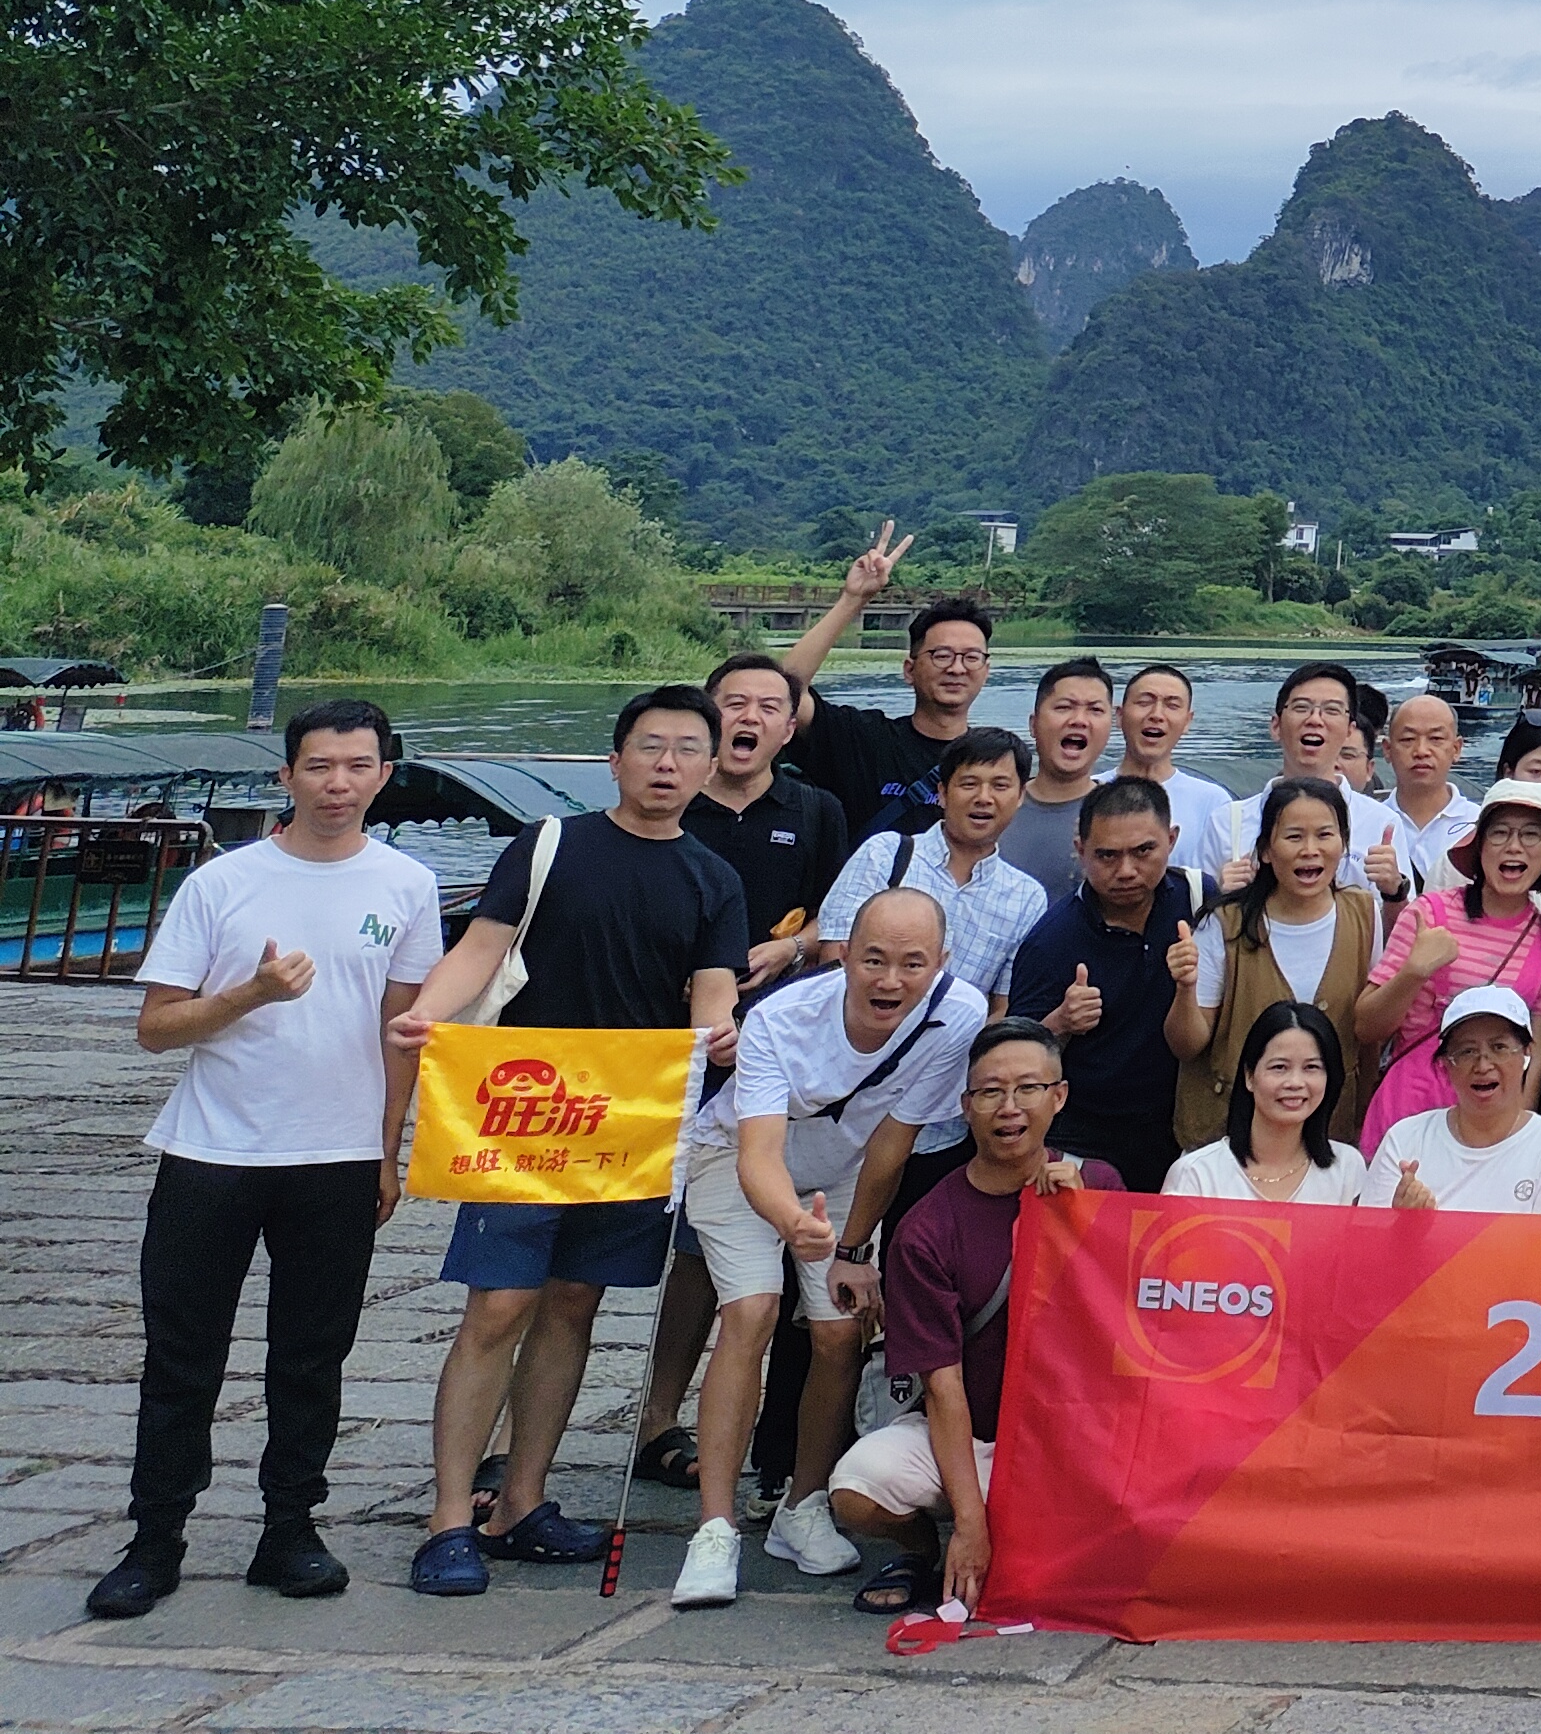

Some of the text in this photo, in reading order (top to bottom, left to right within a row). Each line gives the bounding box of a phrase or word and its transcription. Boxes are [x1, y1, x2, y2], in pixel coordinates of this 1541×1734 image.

[359, 913, 398, 948] AW
[478, 1093, 612, 1138] 旺游
[1136, 1277, 1274, 1318] ENEOS
